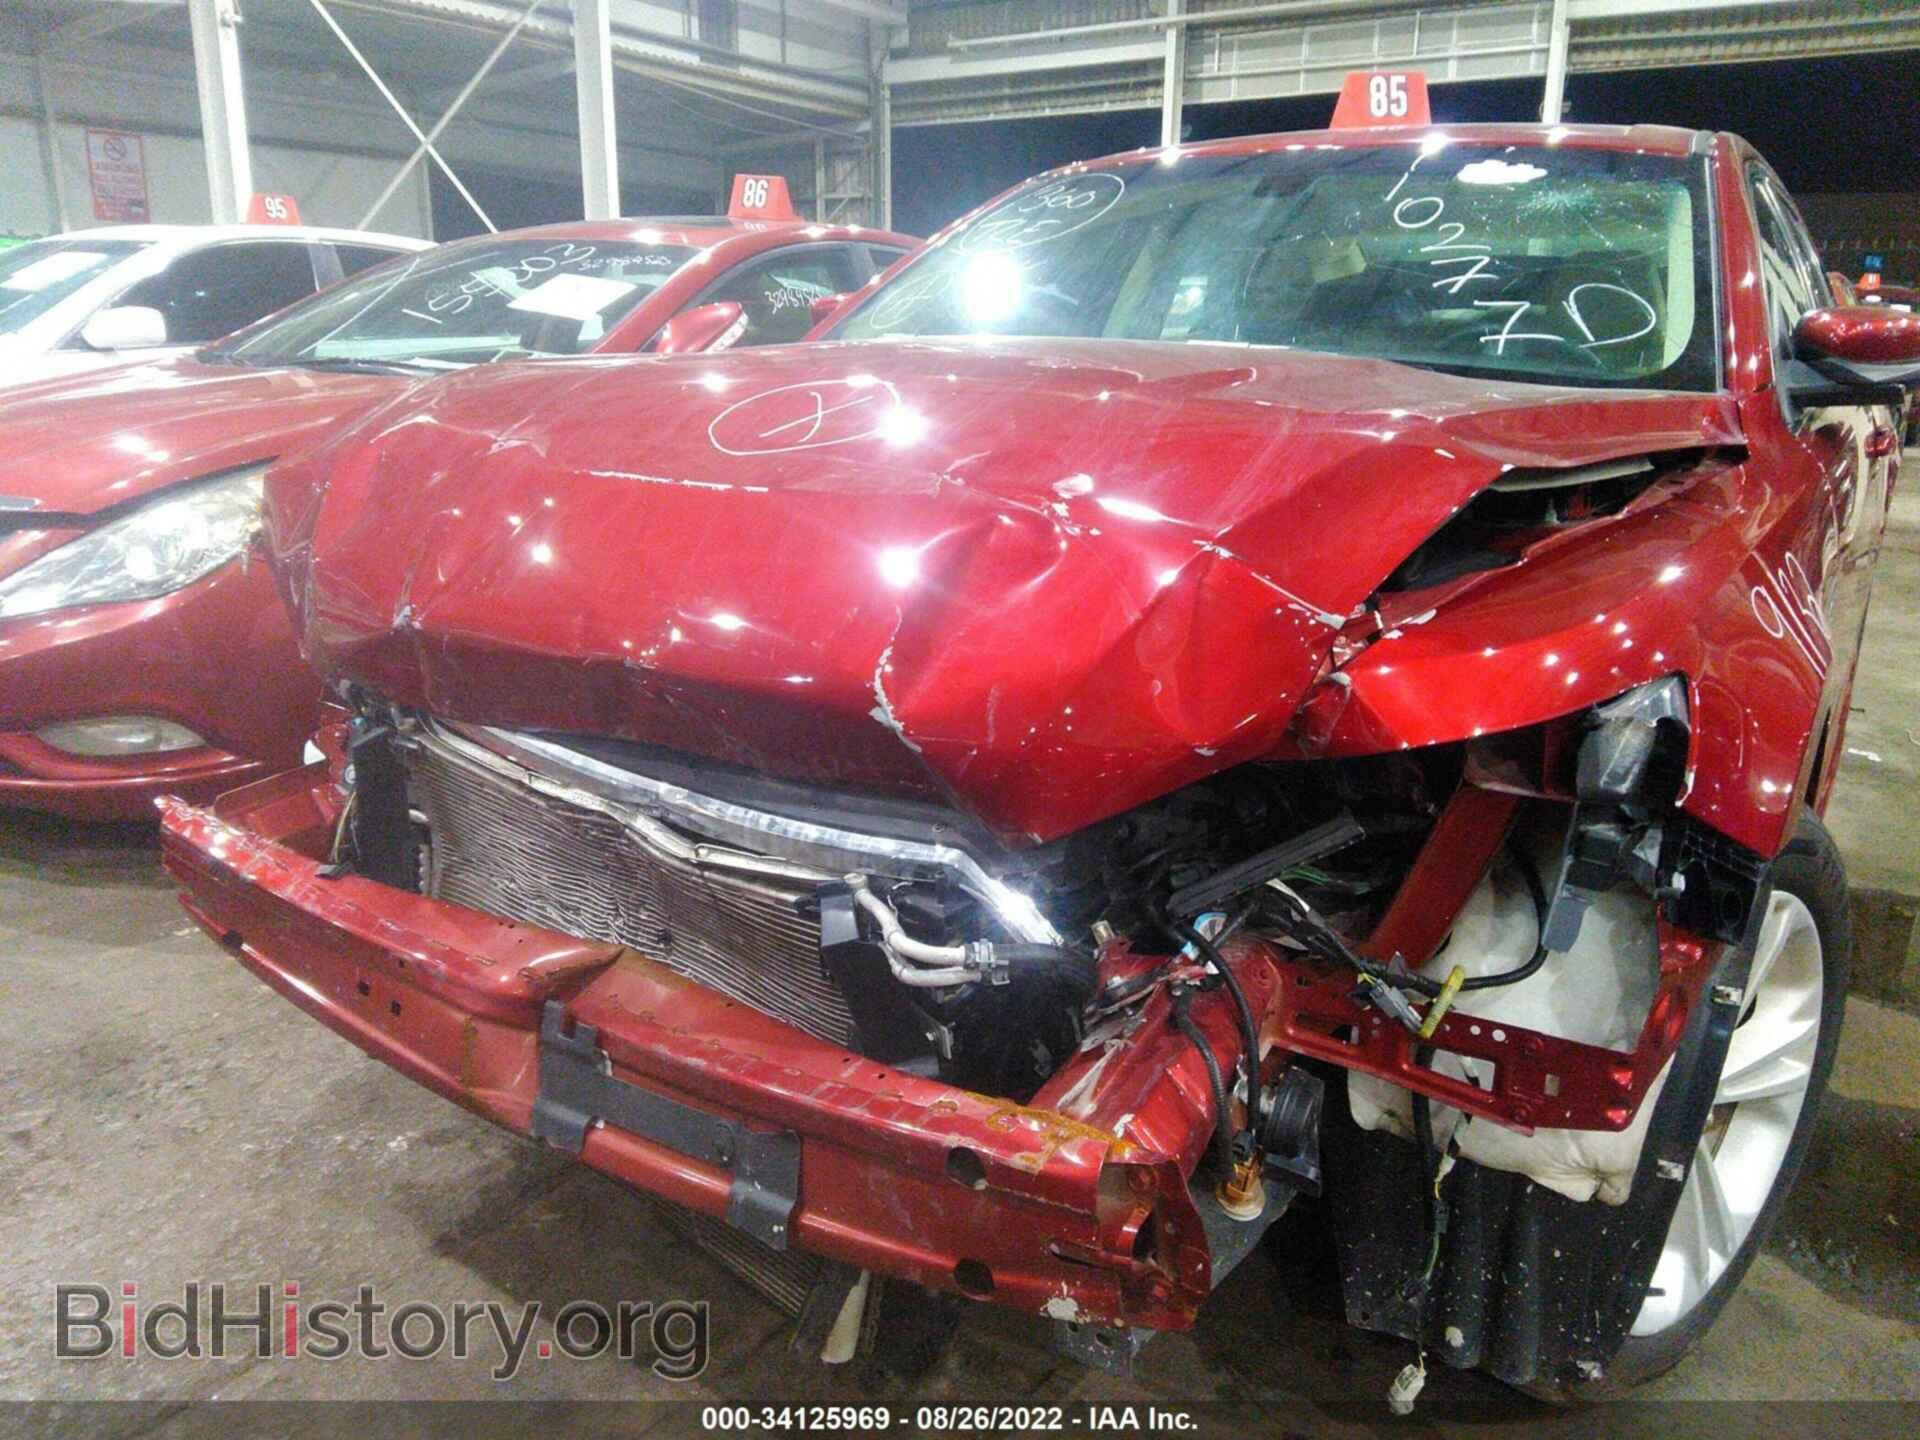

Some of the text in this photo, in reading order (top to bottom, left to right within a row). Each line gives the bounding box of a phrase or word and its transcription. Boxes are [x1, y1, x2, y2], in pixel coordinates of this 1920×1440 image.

[1369, 74, 1408, 118] 85
[264, 196, 288, 219] 95
[742, 178, 769, 209] 86
